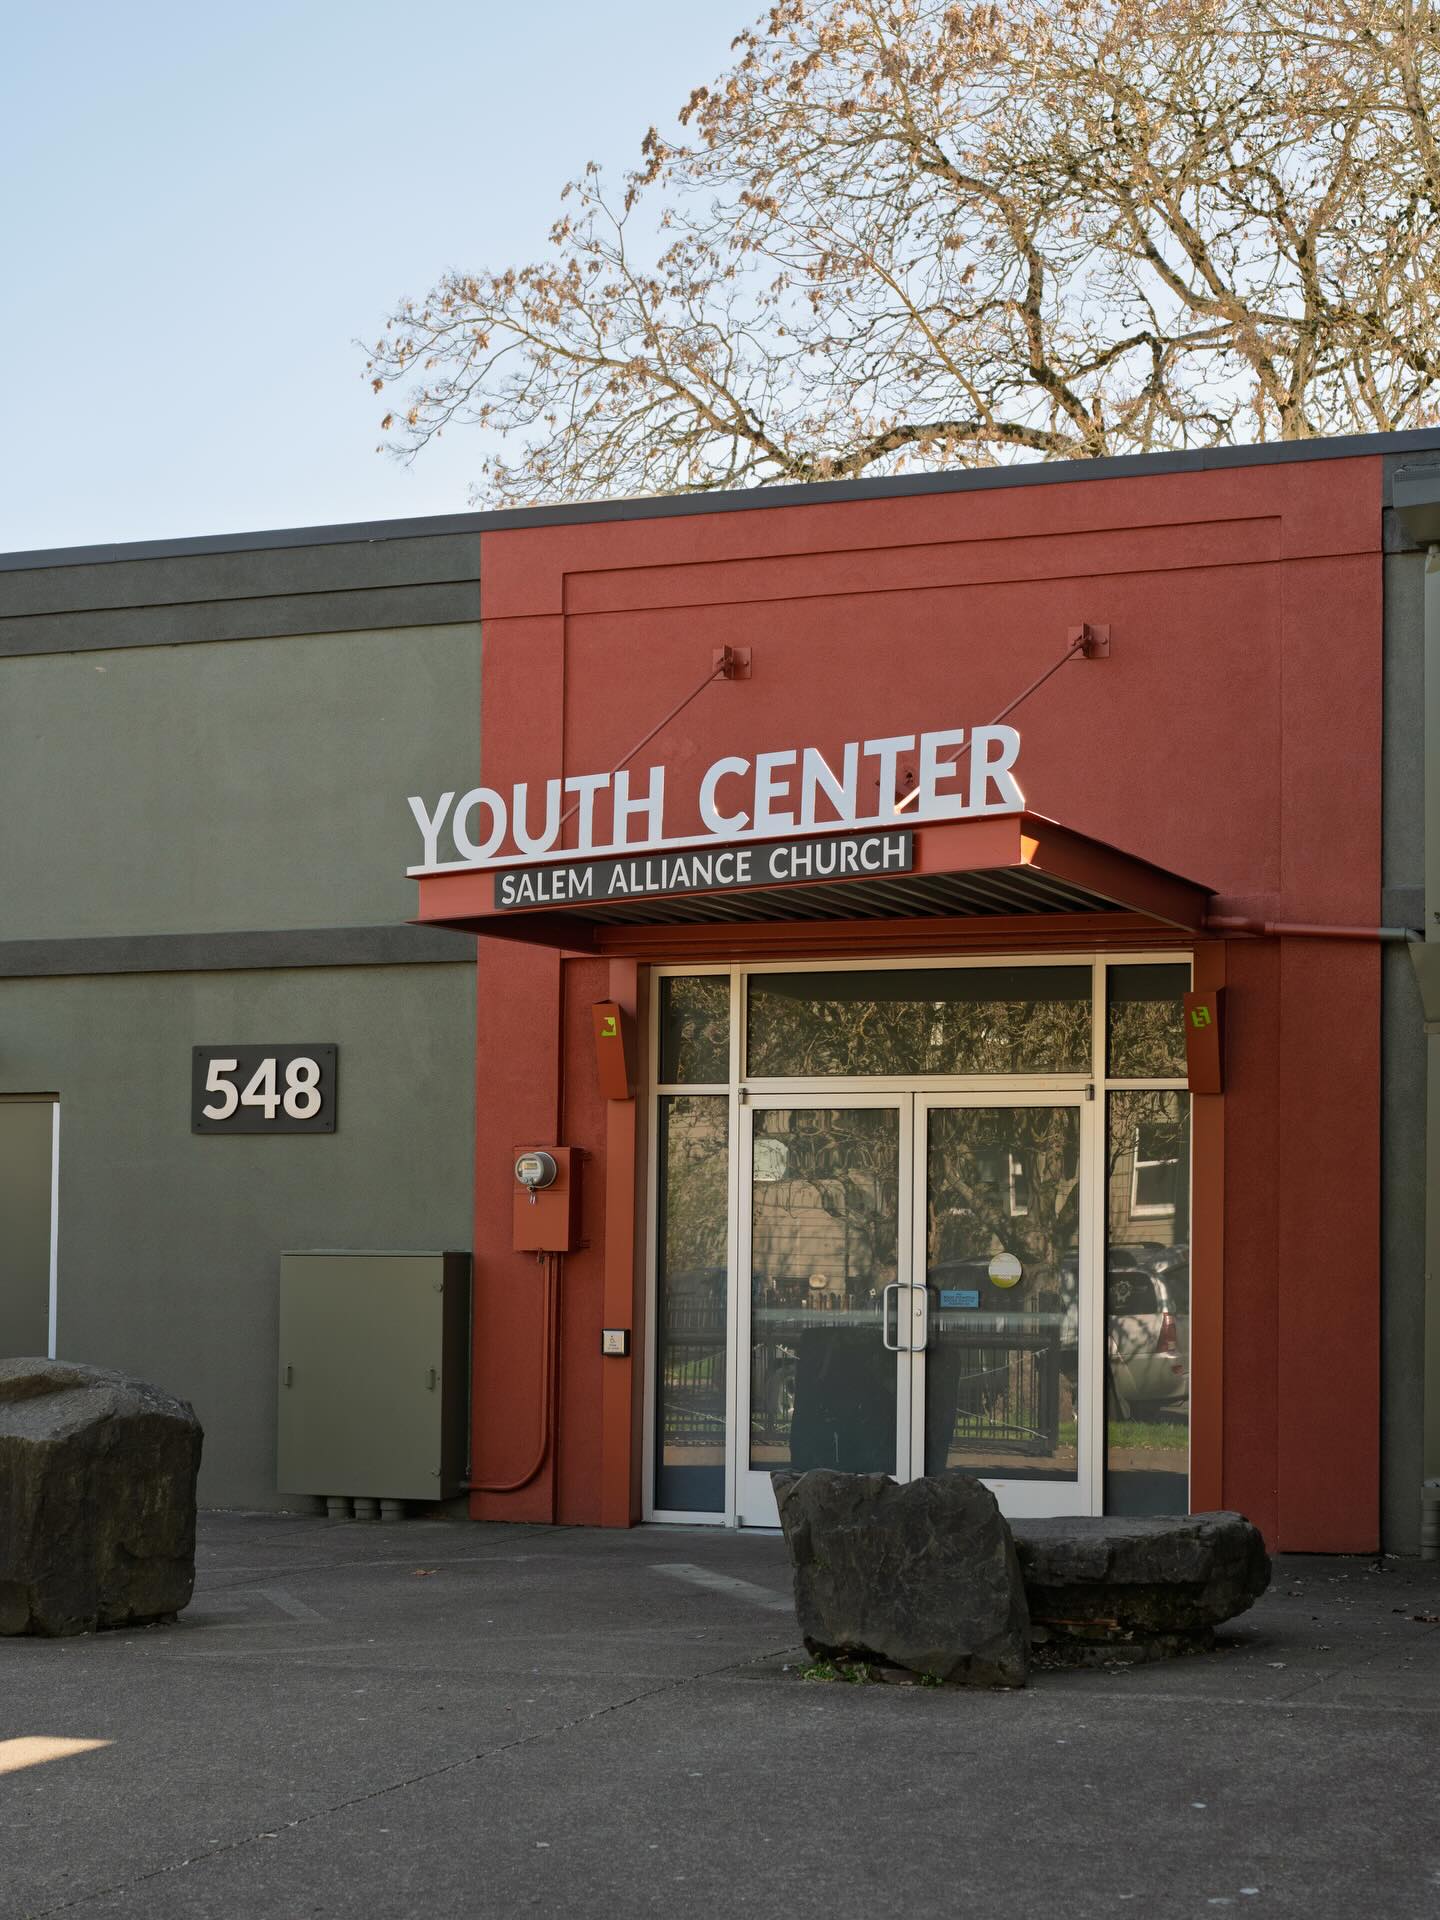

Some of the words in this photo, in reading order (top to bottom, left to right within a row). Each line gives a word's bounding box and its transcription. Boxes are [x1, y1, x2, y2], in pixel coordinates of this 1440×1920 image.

[406, 765, 665, 867] YOUTH
[699, 724, 1025, 834] CENTER
[501, 867, 593, 904] SALEM
[607, 850, 752, 894] ALLIANCE
[768, 835, 906, 879] CHURCH
[202, 1057, 322, 1120] 548
